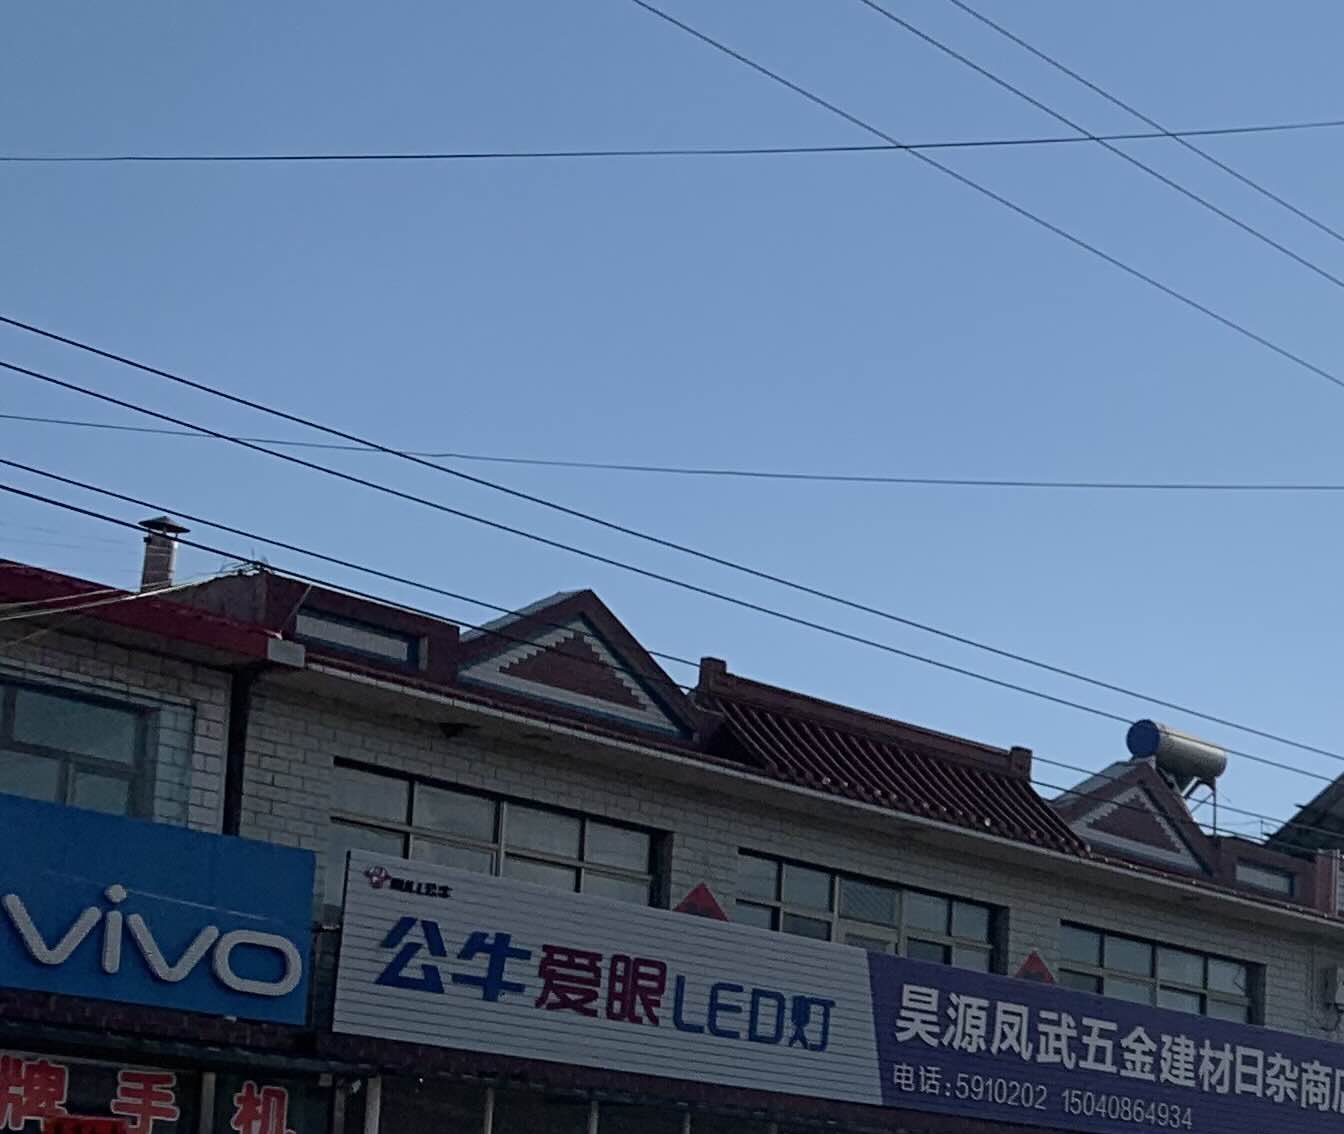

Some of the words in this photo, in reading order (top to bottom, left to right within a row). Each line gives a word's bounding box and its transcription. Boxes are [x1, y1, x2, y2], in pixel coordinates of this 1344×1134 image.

[3, 884, 302, 997] vivo
[375, 915, 836, 1053] 公牛爱眼LED灯
[1061, 1088, 1193, 1130] 15040864934
